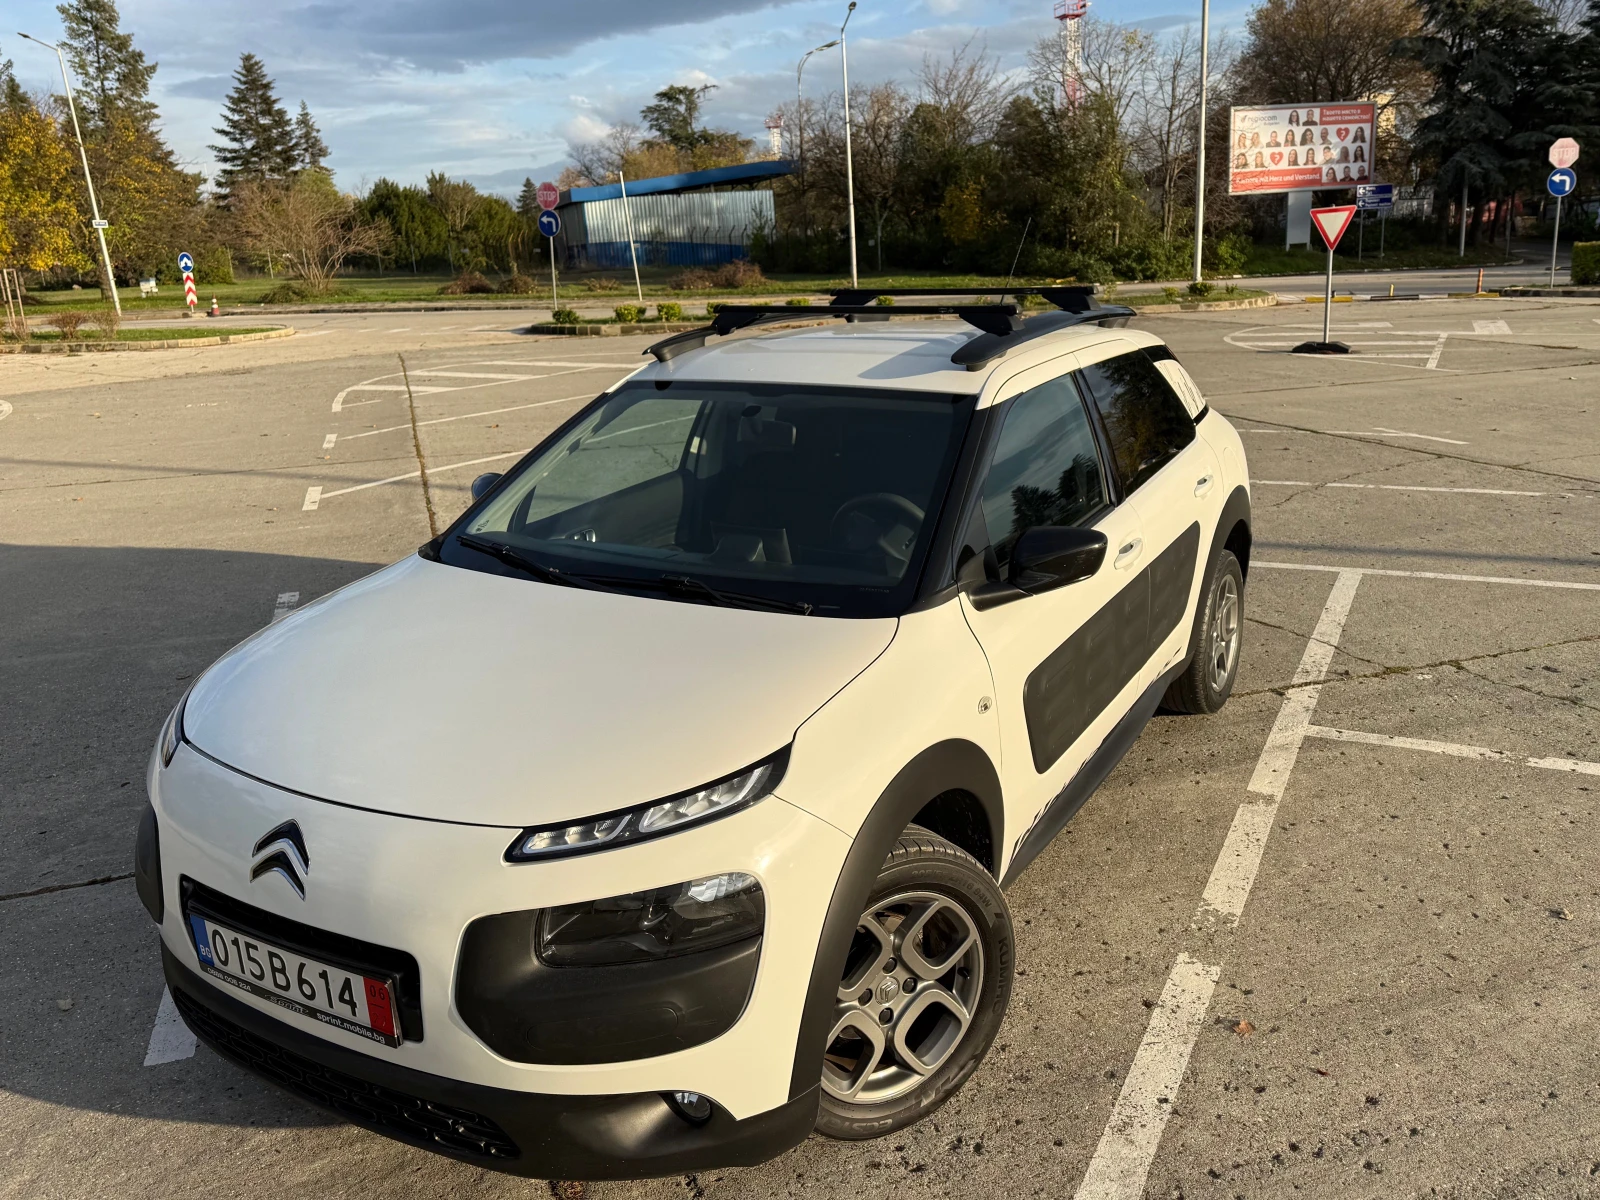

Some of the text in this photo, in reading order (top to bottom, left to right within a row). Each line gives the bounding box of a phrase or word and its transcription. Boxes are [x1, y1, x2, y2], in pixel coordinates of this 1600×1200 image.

[1248, 115, 1278, 123] regiocom
[1553, 148, 1576, 158] STOP
[538, 191, 557, 201] STOP
[199, 944, 212, 959] BG
[211, 928, 358, 1017] 015B614
[992, 937, 1009, 1014] KUMHO
[369, 984, 386, 1001] 06
[316, 1012, 386, 1045] sprint.mobile.bg
